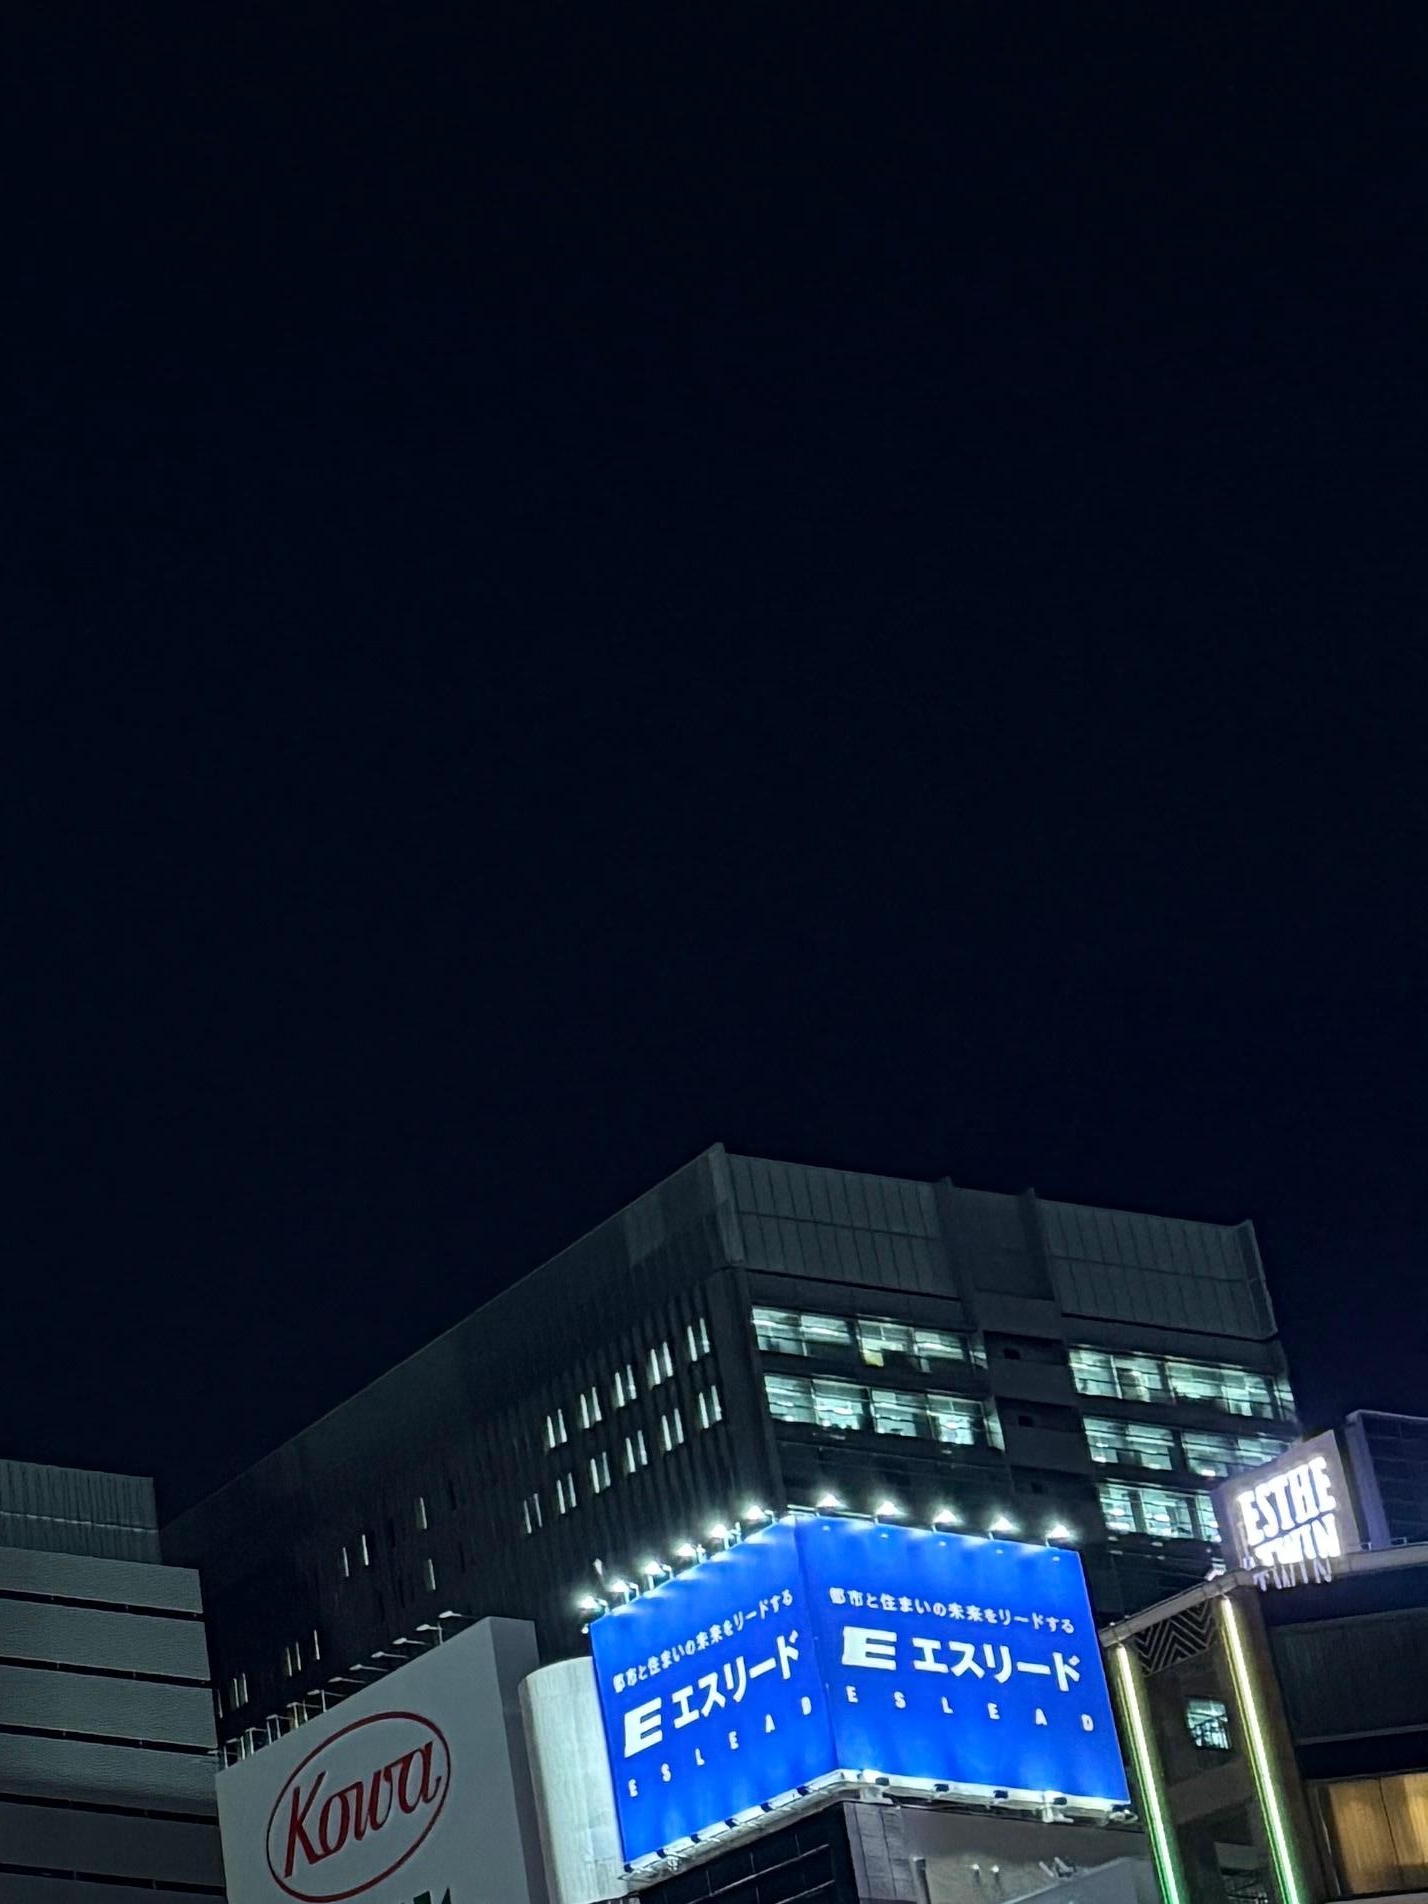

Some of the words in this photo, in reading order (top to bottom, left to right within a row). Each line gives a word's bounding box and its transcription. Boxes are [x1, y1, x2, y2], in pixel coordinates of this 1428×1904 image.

[1236, 1456, 1337, 1547] ESTHE
[1254, 1513, 1342, 1567] TWIN
[829, 1587, 1074, 1634] 都市と住まいの未来をリードする
[672, 1629, 799, 1729] エスリード
[912, 1637, 1081, 1692] エスリード
[284, 1741, 442, 1878] Kowa
